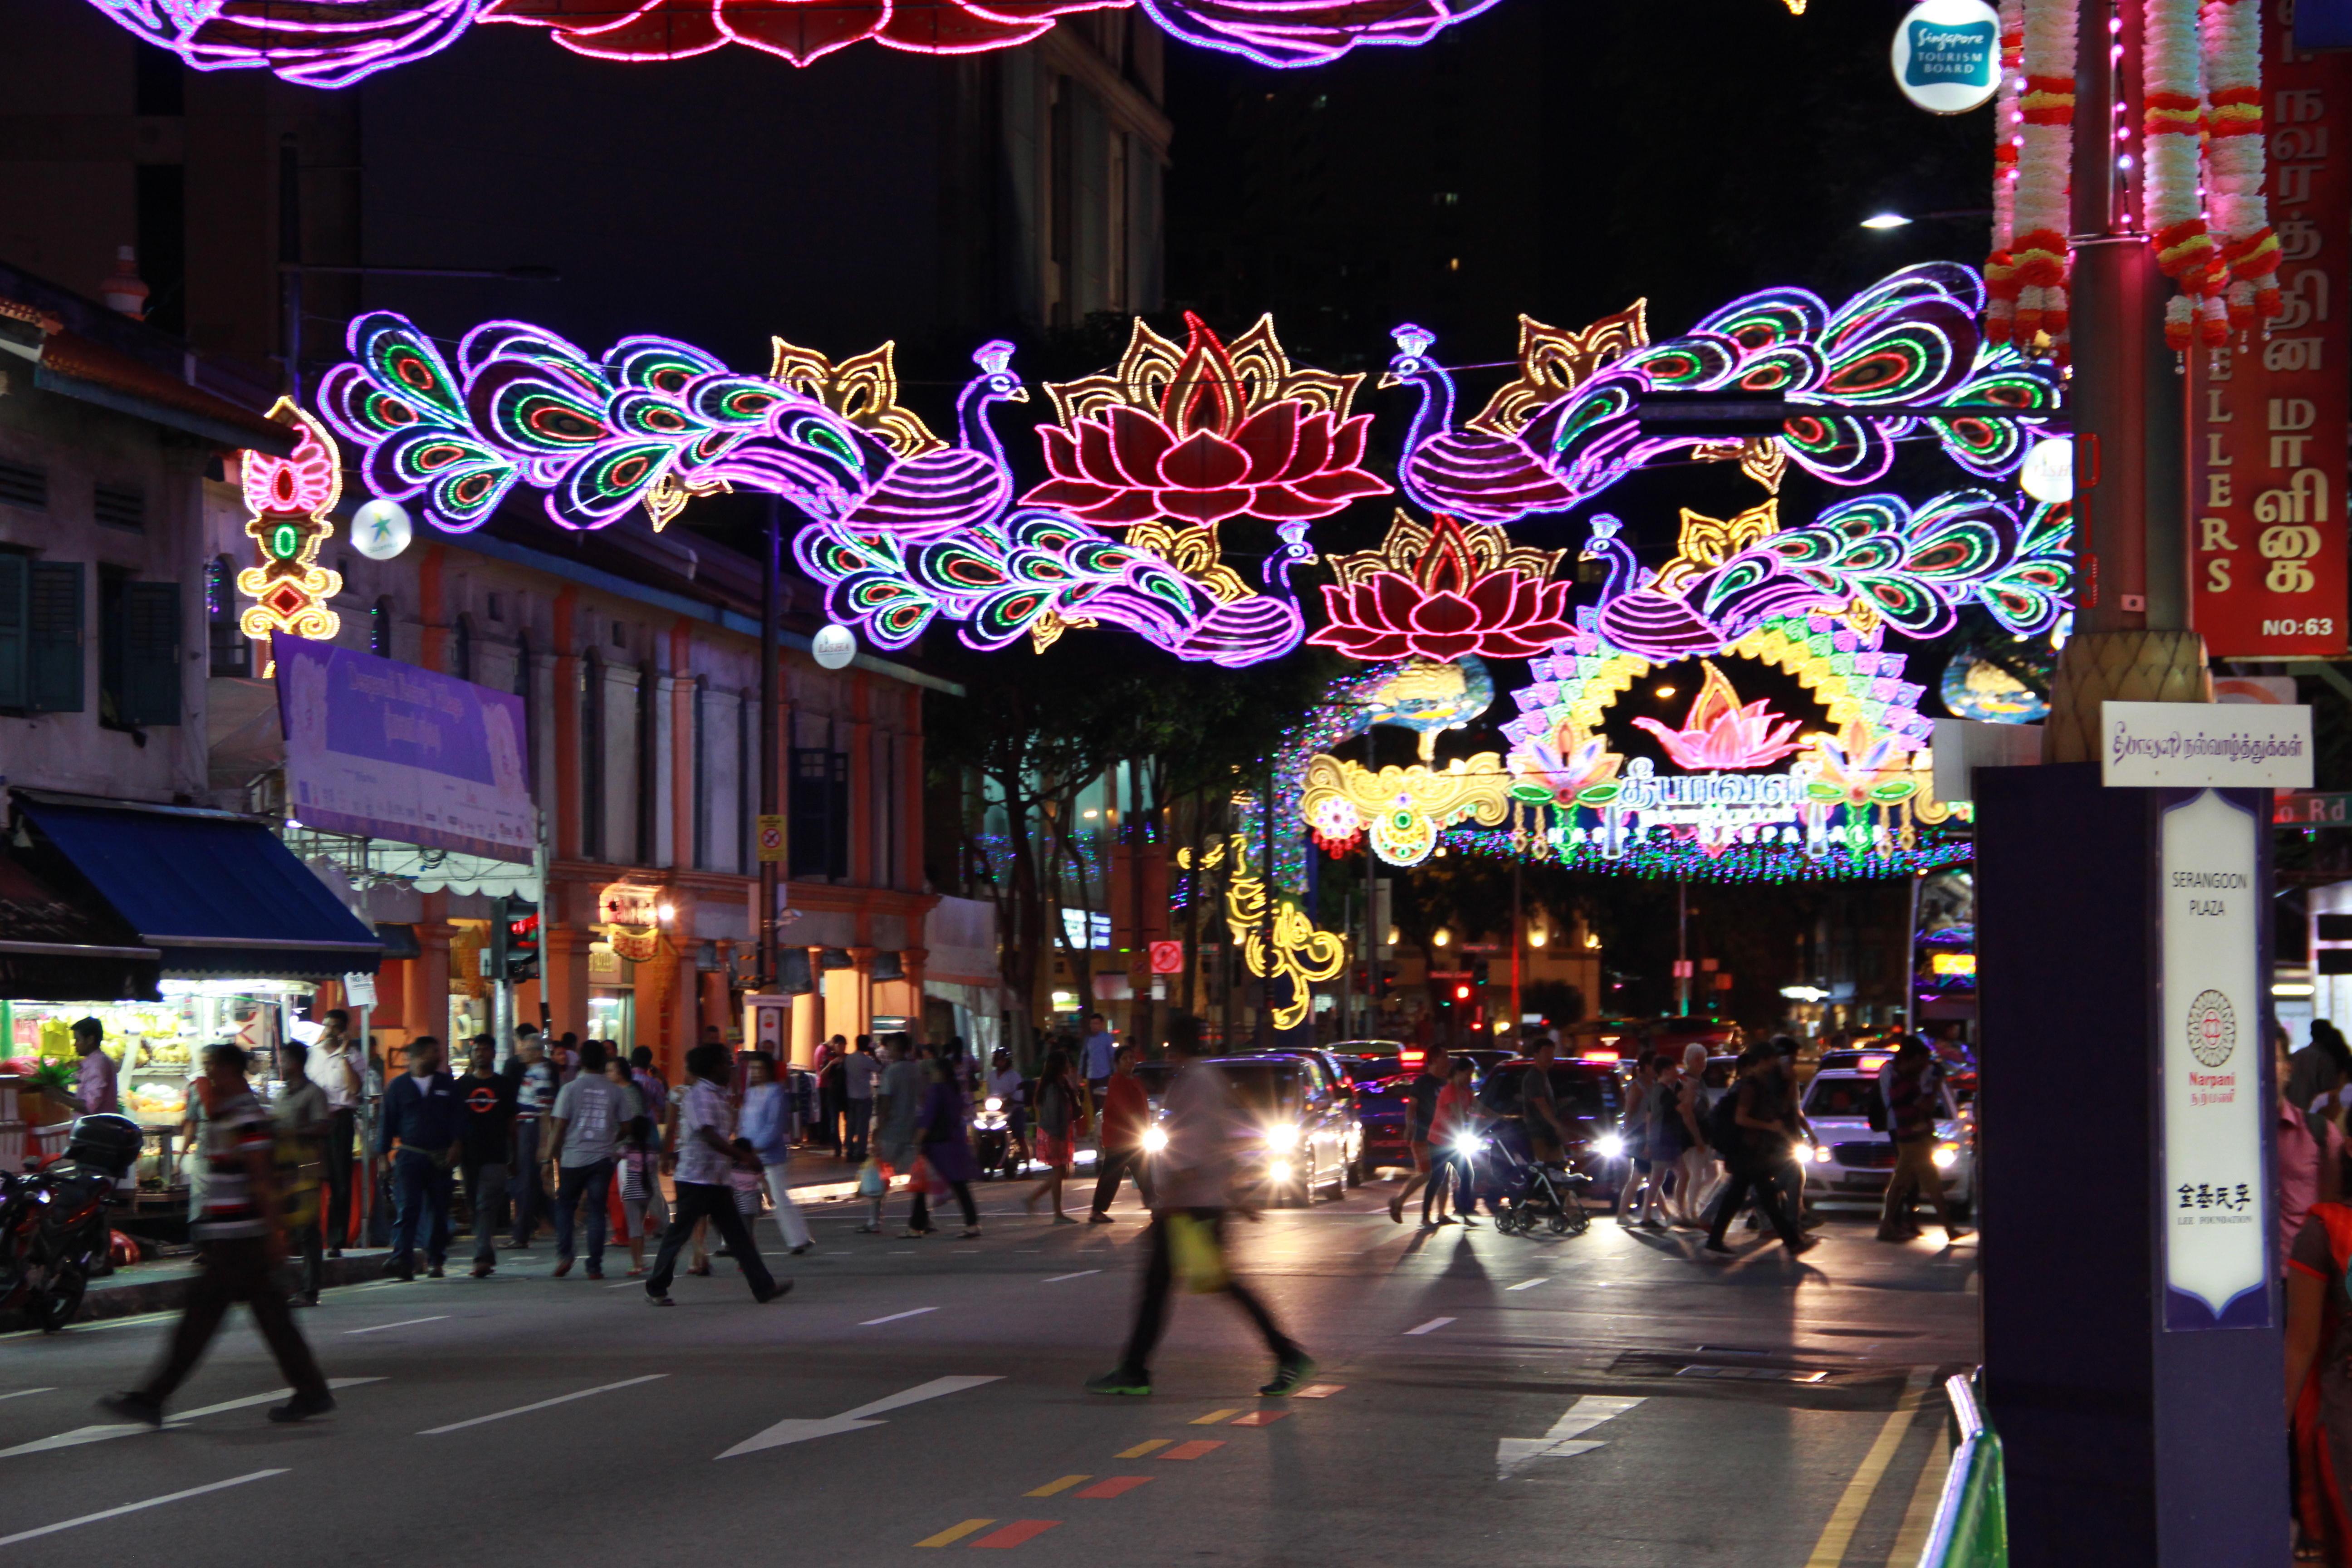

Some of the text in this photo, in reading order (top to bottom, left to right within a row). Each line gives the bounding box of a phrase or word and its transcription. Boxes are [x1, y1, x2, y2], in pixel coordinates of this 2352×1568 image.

[1918, 28, 1984, 51] Singapore
[1918, 52, 1983, 62] TOURISM
[1924, 64, 1975, 74] BOARD
[2263, 617, 2334, 636] NO:63
[2309, 798, 2346, 821] Rd
[1547, 825, 1886, 844] HAPPY DEEPAVALI
[2171, 871, 2248, 889] SERANGOON
[2189, 899, 2225, 916] PLAZA
[2189, 1072, 2236, 1089] Narpani
[2177, 1215, 2253, 1225] LEE FOUNDATION
